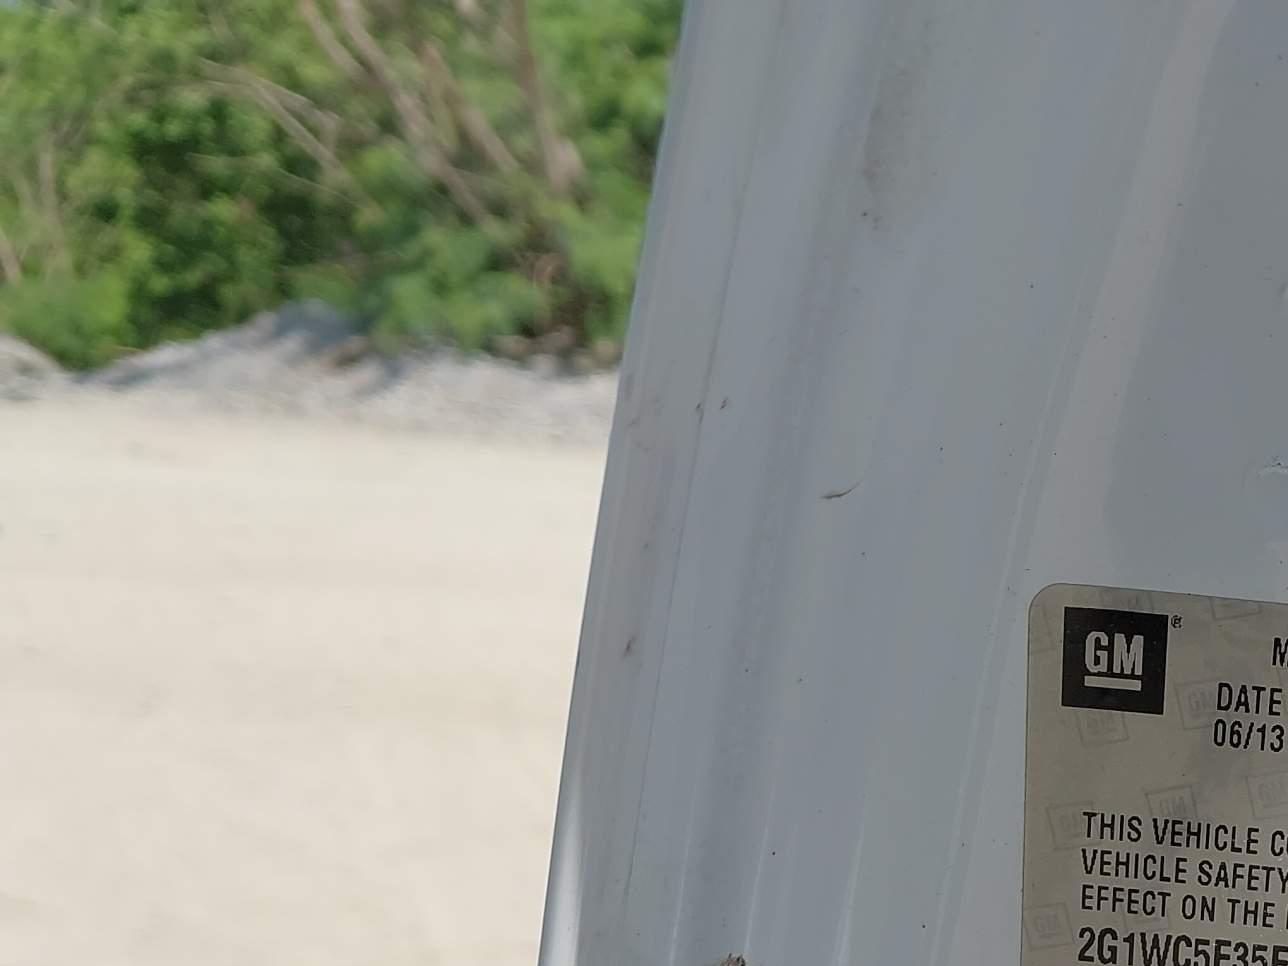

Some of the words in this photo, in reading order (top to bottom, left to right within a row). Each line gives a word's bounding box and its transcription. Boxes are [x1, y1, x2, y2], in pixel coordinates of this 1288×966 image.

[1085, 631, 1143, 676] GM
[1216, 682, 1284, 717] DATE
[1213, 720, 1284, 753] 06/13
[1082, 811, 1143, 842] THIS
[1152, 818, 1260, 855] VEHICLE
[1081, 848, 1188, 885] VEHICLE
[1081, 884, 1171, 919] EFFECT
[1181, 895, 1215, 923] ON
[1227, 898, 1275, 929] THE
